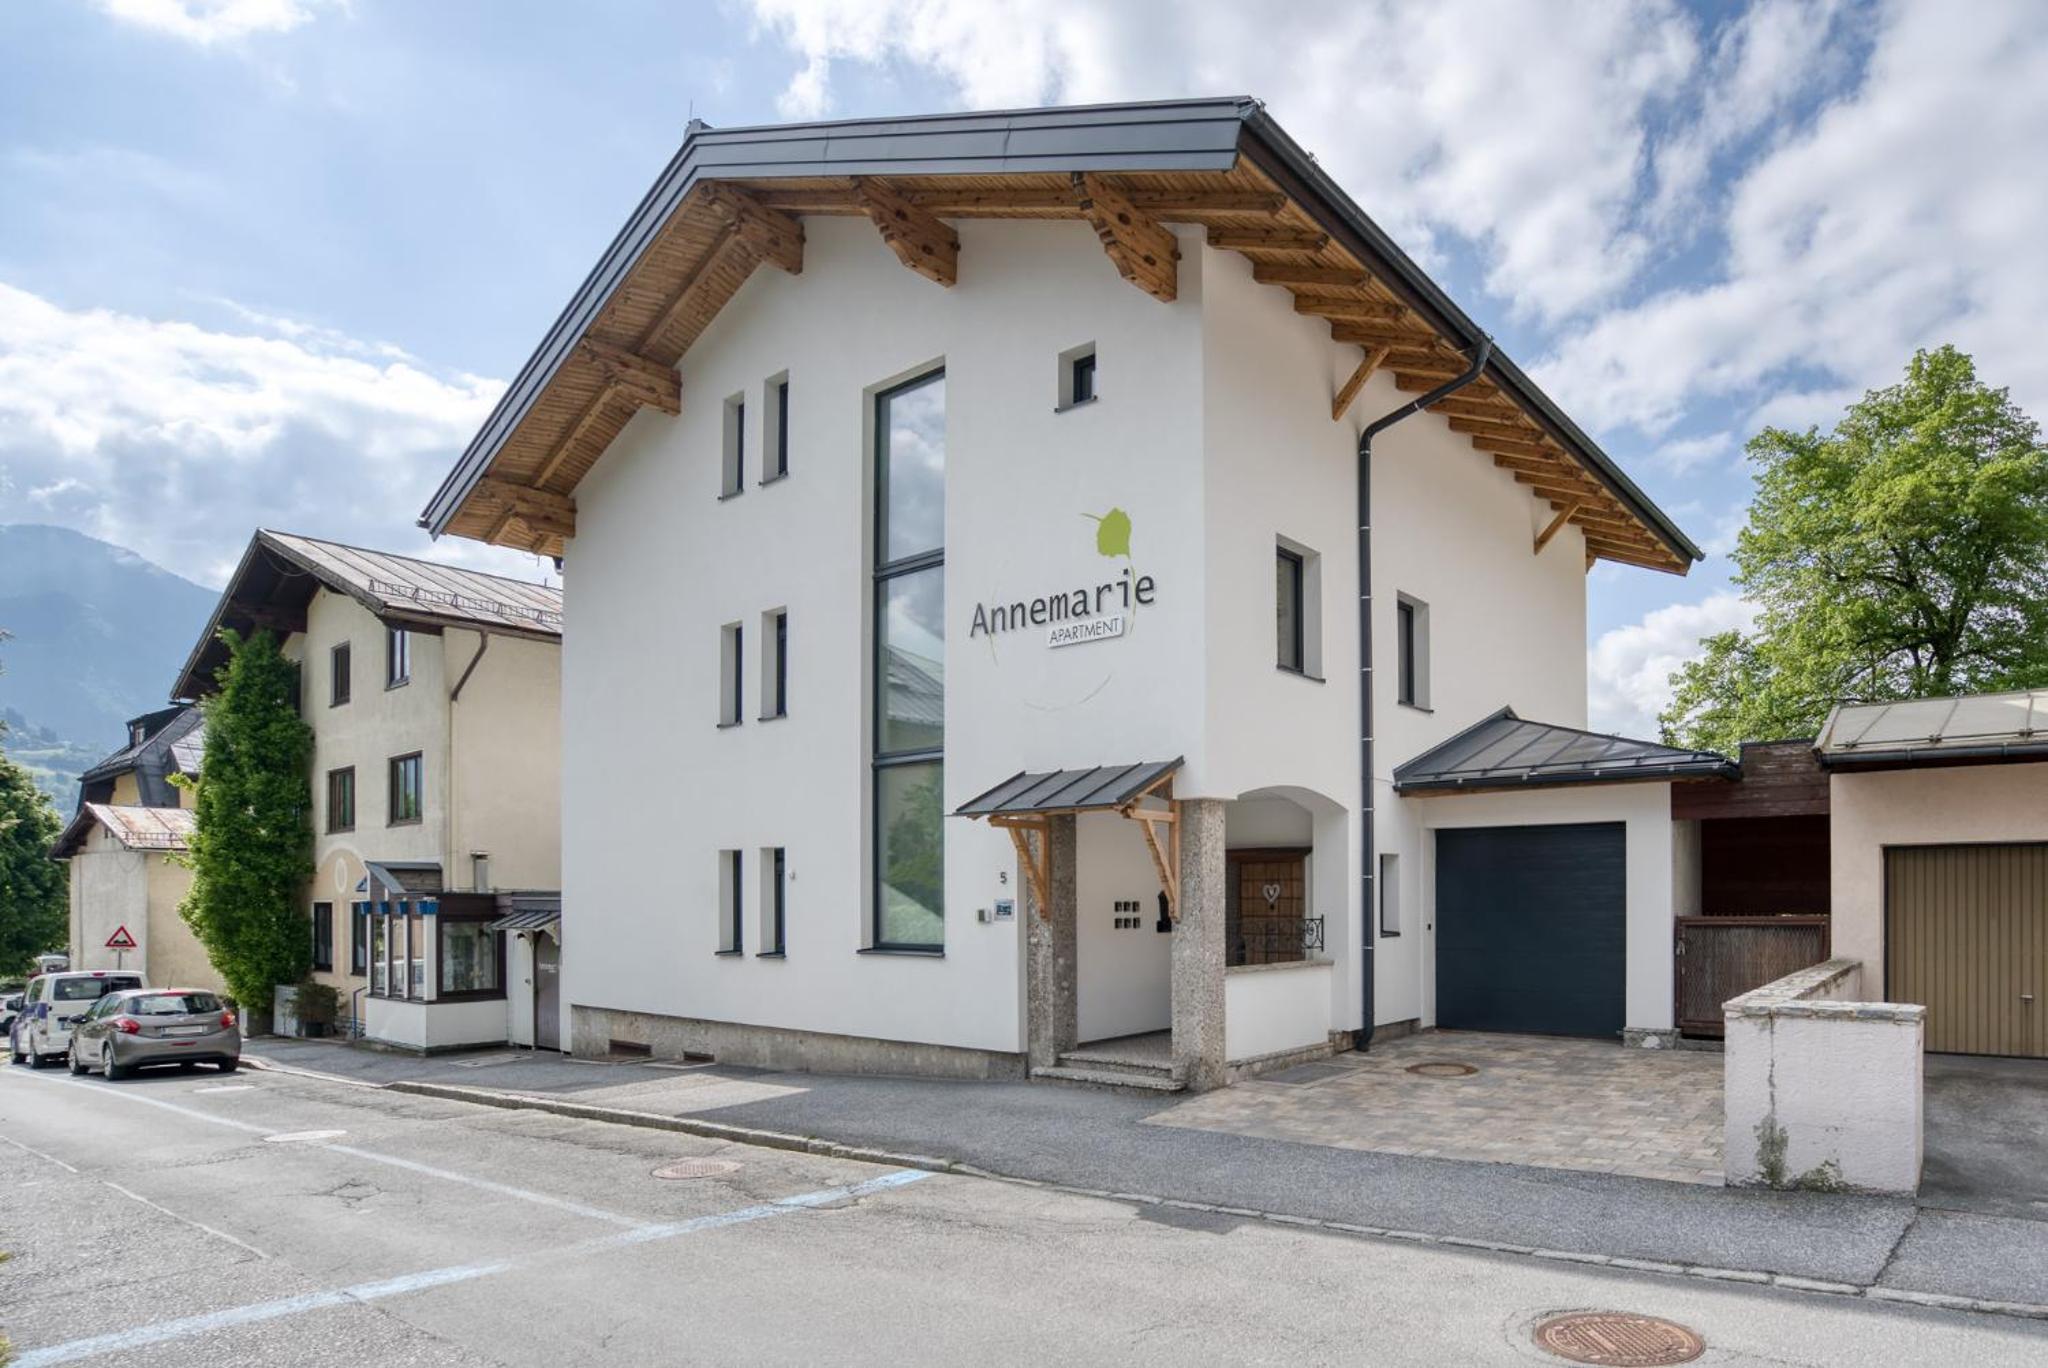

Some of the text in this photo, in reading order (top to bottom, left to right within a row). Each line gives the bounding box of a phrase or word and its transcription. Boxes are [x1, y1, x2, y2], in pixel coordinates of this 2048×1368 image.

[970, 568, 1155, 638] Annemarie
[1049, 617, 1120, 645] APARTMENT
[1000, 871, 1008, 885] 5
